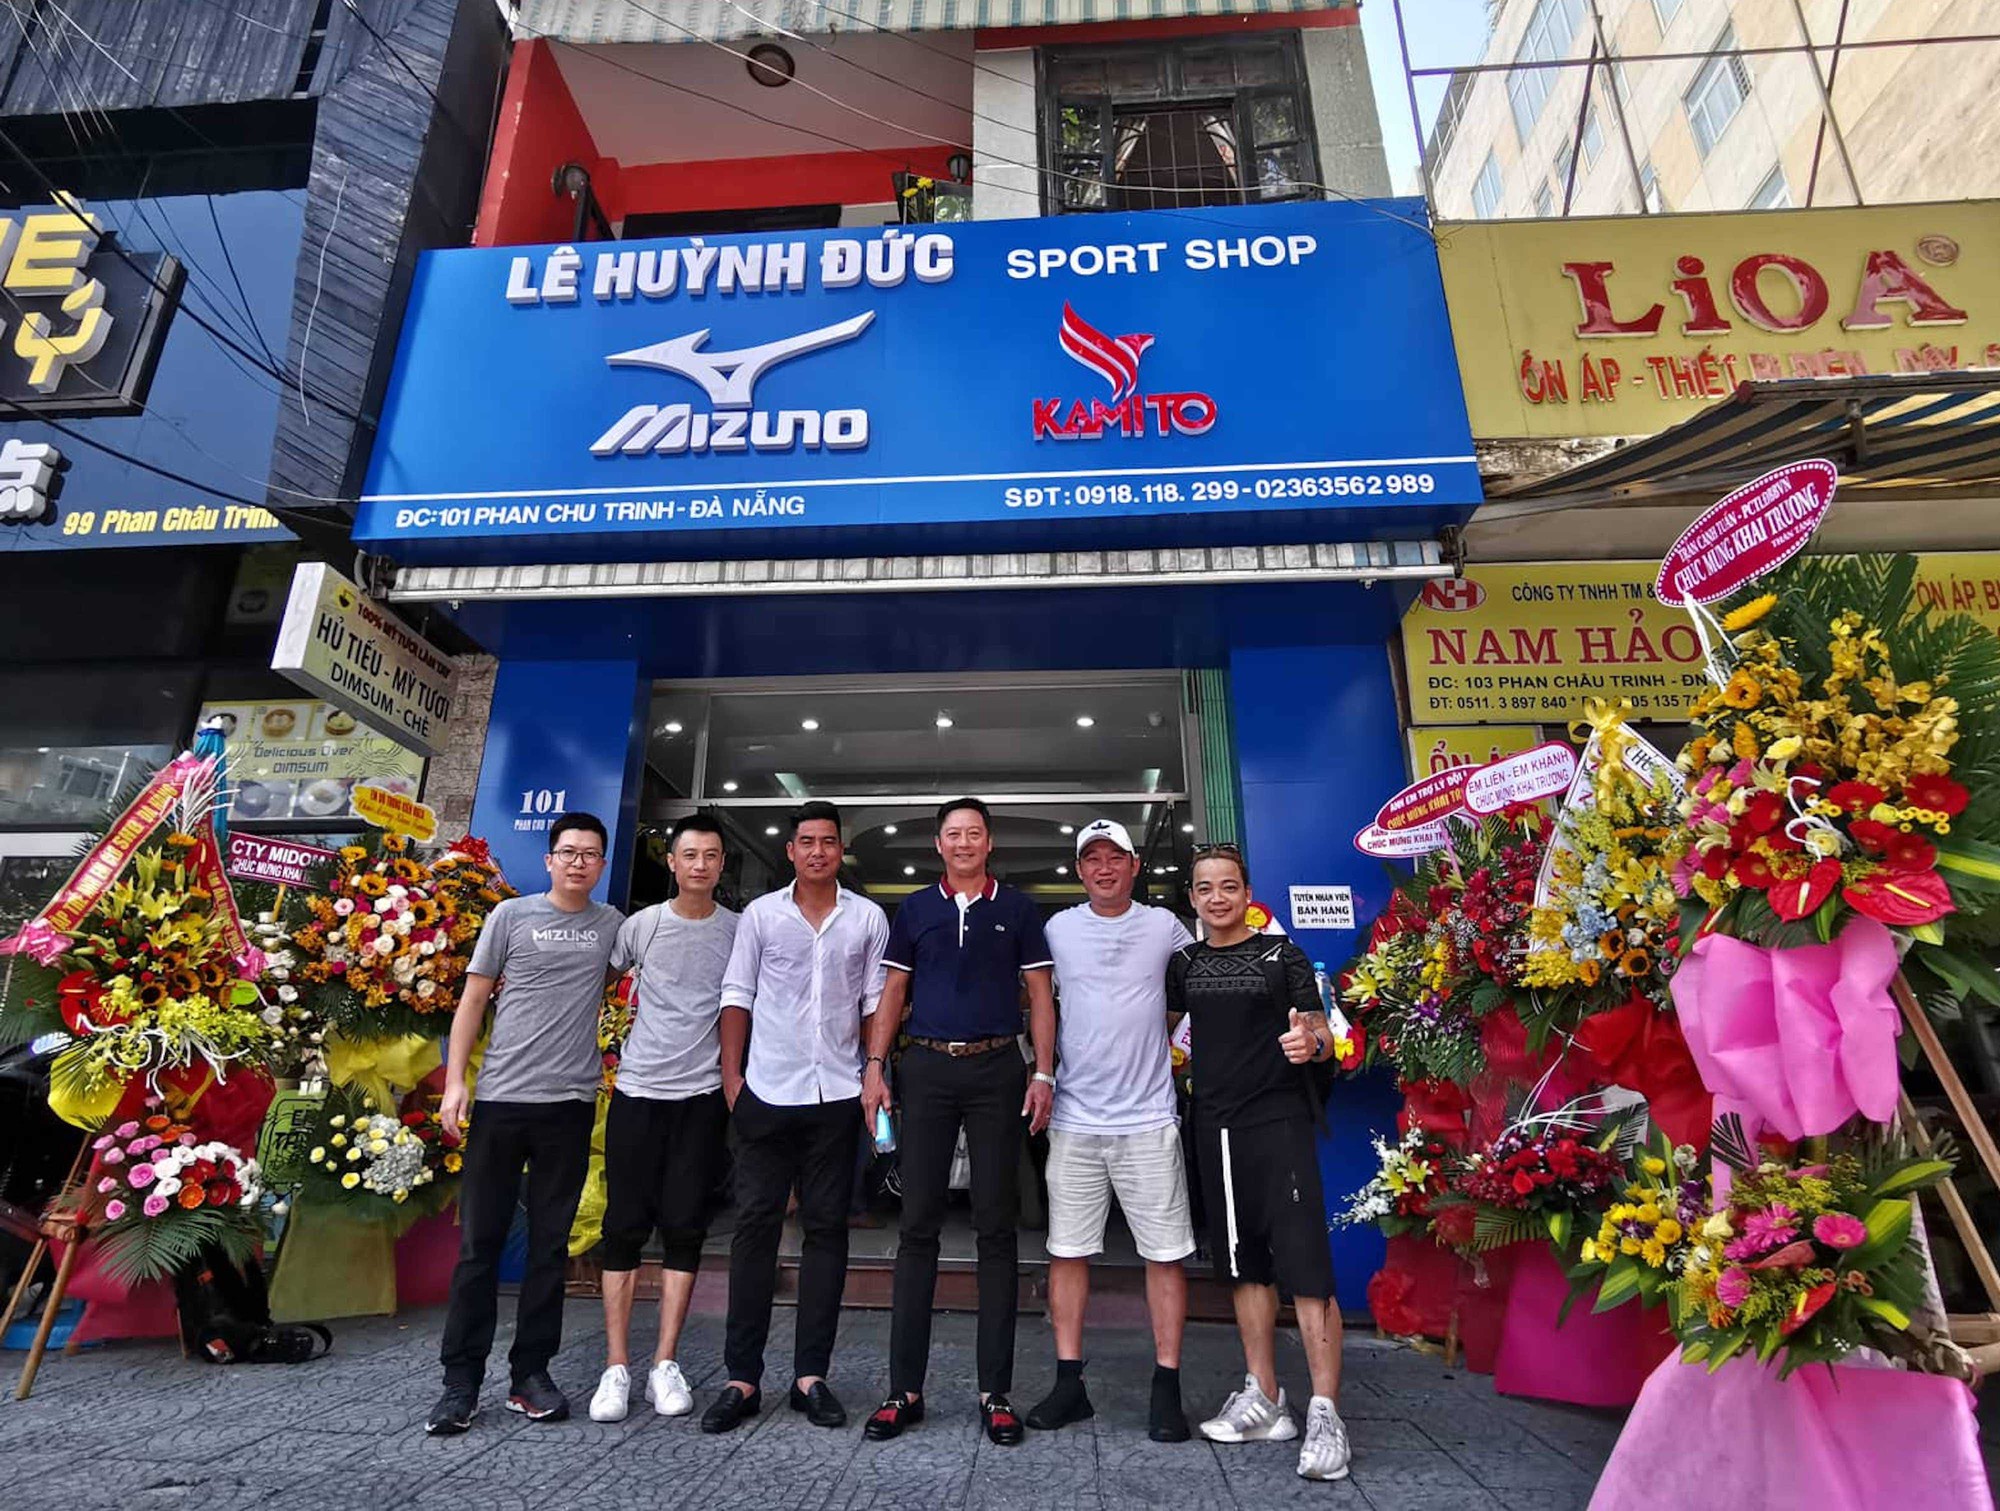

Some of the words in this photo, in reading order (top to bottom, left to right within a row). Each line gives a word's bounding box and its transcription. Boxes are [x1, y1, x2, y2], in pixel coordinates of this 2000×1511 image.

[506, 246, 582, 303] LÊ
[592, 238, 806, 300] HUỲNH
[820, 229, 955, 290] ĐỨC
[1006, 242, 1168, 279] SPORT
[1185, 234, 1318, 270] SHOP
[1580, 352, 1621, 403] ÁP
[588, 403, 869, 456] MIZUNO
[1032, 391, 1218, 442] KAMITO
[63, 512, 96, 536] 99
[100, 509, 158, 534] Phan
[162, 504, 221, 532] Châu
[475, 505, 540, 526] PHAN
[545, 503, 597, 523] CHU
[732, 490, 806, 517] NẴNG
[1731, 517, 1767, 557] KHAI
[1511, 582, 1554, 601] CÔNG
[1558, 585, 1575, 601] TY
[1578, 583, 1618, 601] TNHH
[1621, 583, 1643, 599] TM
[1426, 627, 1562, 665] NAM
[1575, 608, 1704, 664] HẢO
[316, 612, 345, 651] HỦ
[346, 632, 383, 678] TIẾU
[392, 666, 418, 700] MỲ
[418, 681, 450, 723] TƯƠI
[1428, 676, 1459, 689] ĐC:
[1464, 676, 1493, 689] 103
[1498, 676, 1549, 689] PHAN
[1553, 673, 1604, 688] CHÂU
[1609, 675, 1665, 688] TRINH
[1681, 674, 1708, 687] ĐN
[330, 661, 394, 716] DIMSUM
[403, 708, 430, 738] CHÈ
[1429, 696, 1453, 709] ĐT:
[1499, 696, 1507, 709] 3
[1511, 696, 1536, 709] 897
[1541, 696, 1568, 709] 840
[1652, 695, 1680, 708] 135
[1468, 779, 1483, 794] EM
[1512, 763, 1529, 778] EM
[1517, 779, 1535, 795] KHAI
[519, 789, 567, 814] 101
[231, 838, 266, 859] CTY
[1414, 831, 1433, 843] KHAI
[532, 929, 599, 942] MIZUNO
